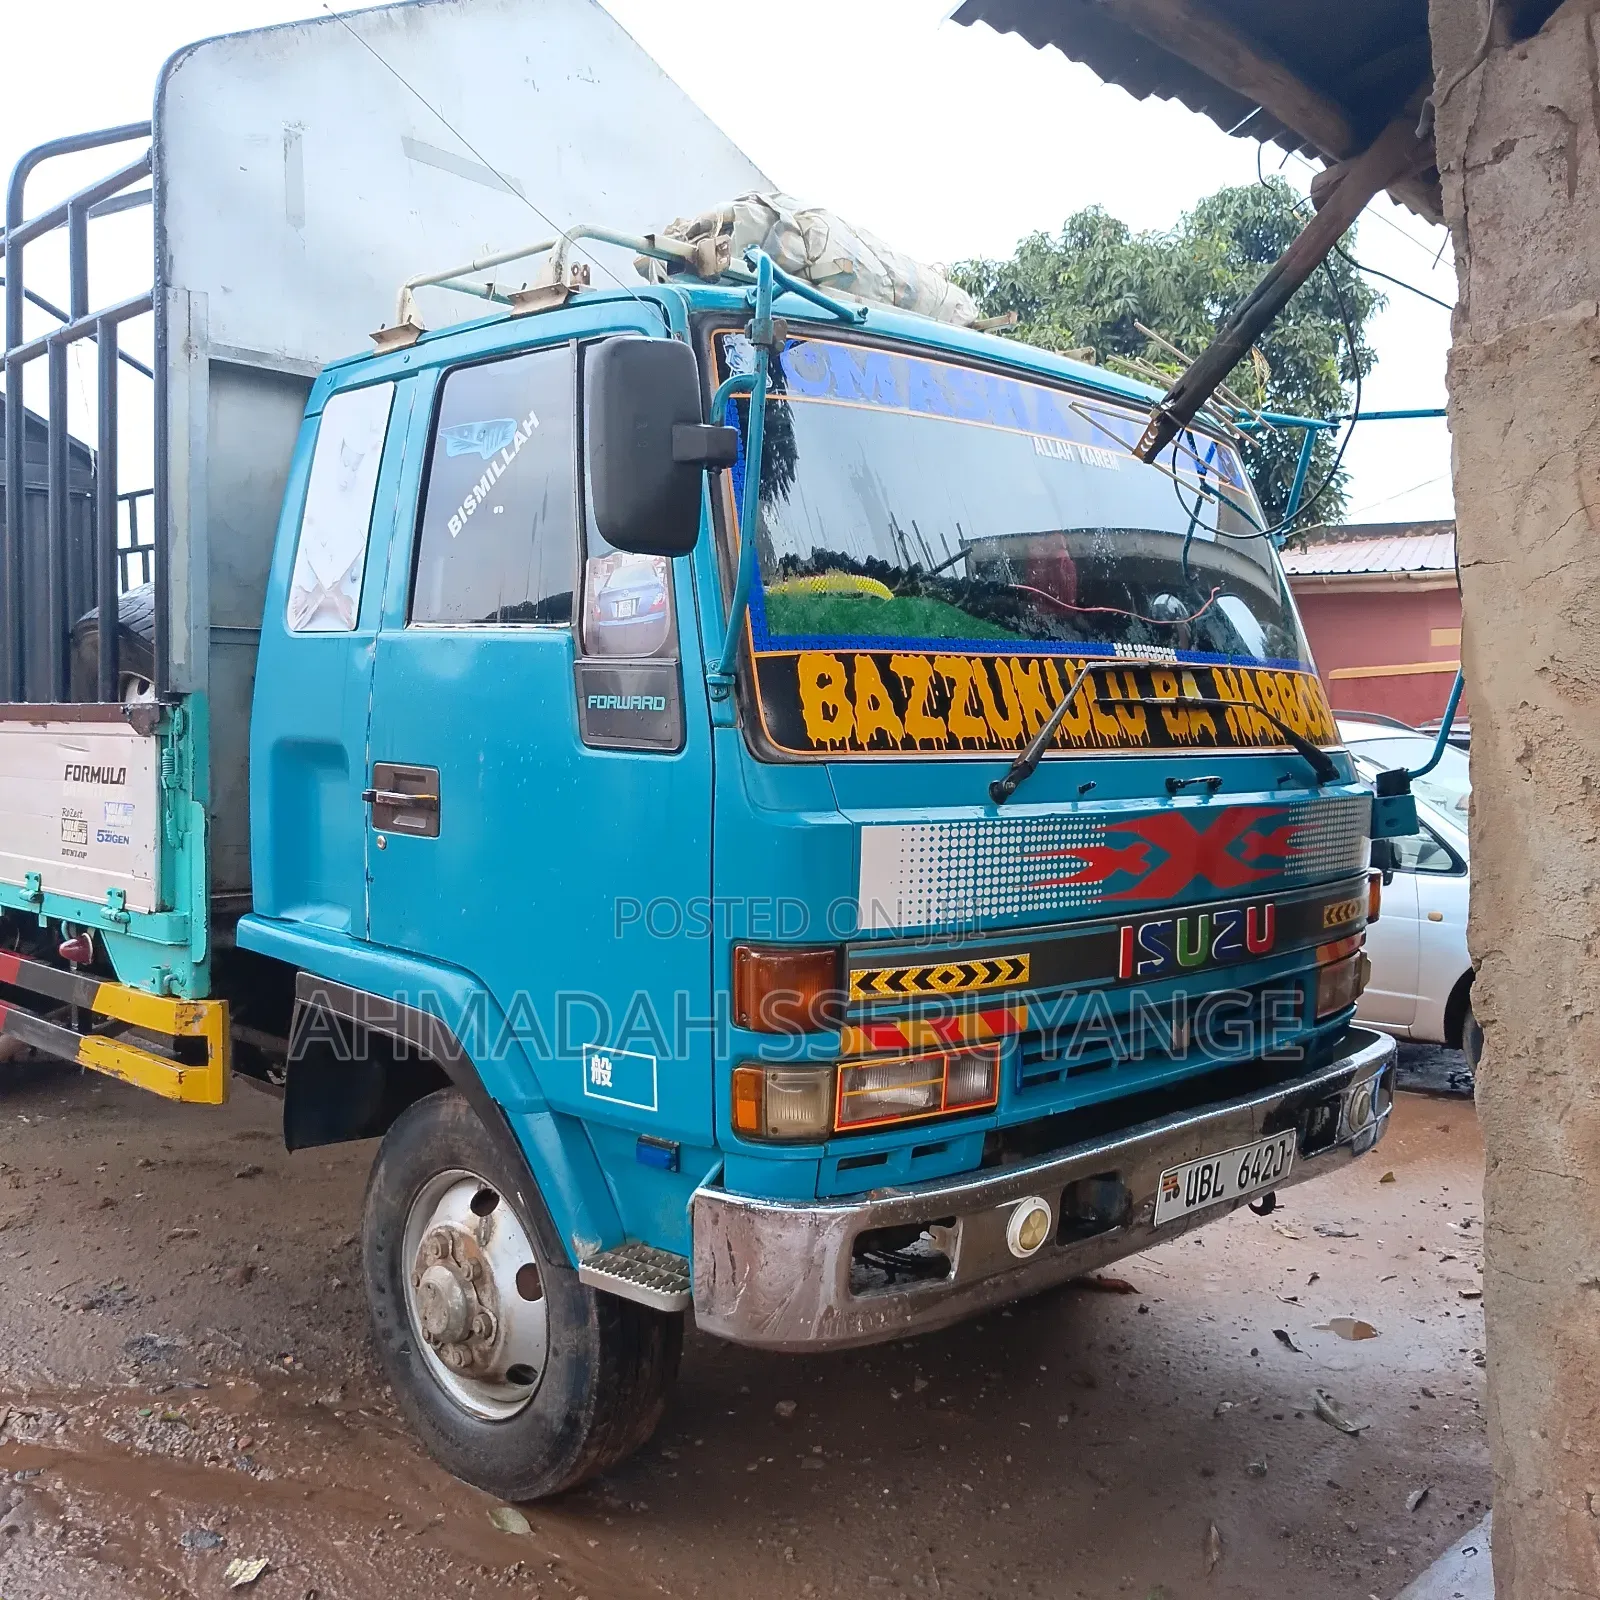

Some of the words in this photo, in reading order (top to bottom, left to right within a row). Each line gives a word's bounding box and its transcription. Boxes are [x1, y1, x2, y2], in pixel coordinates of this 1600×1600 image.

[1032, 436, 1076, 462] ALLAH
[447, 410, 540, 538] BISMILLAH
[588, 695, 666, 711] FORWARD
[96, 829, 130, 844] 5ZIGEN
[1119, 903, 1275, 979] ISUZU
[590, 1053, 613, 1088] 般
[1184, 1160, 1225, 1208] UBL
[1236, 1139, 1286, 1190] 642J
